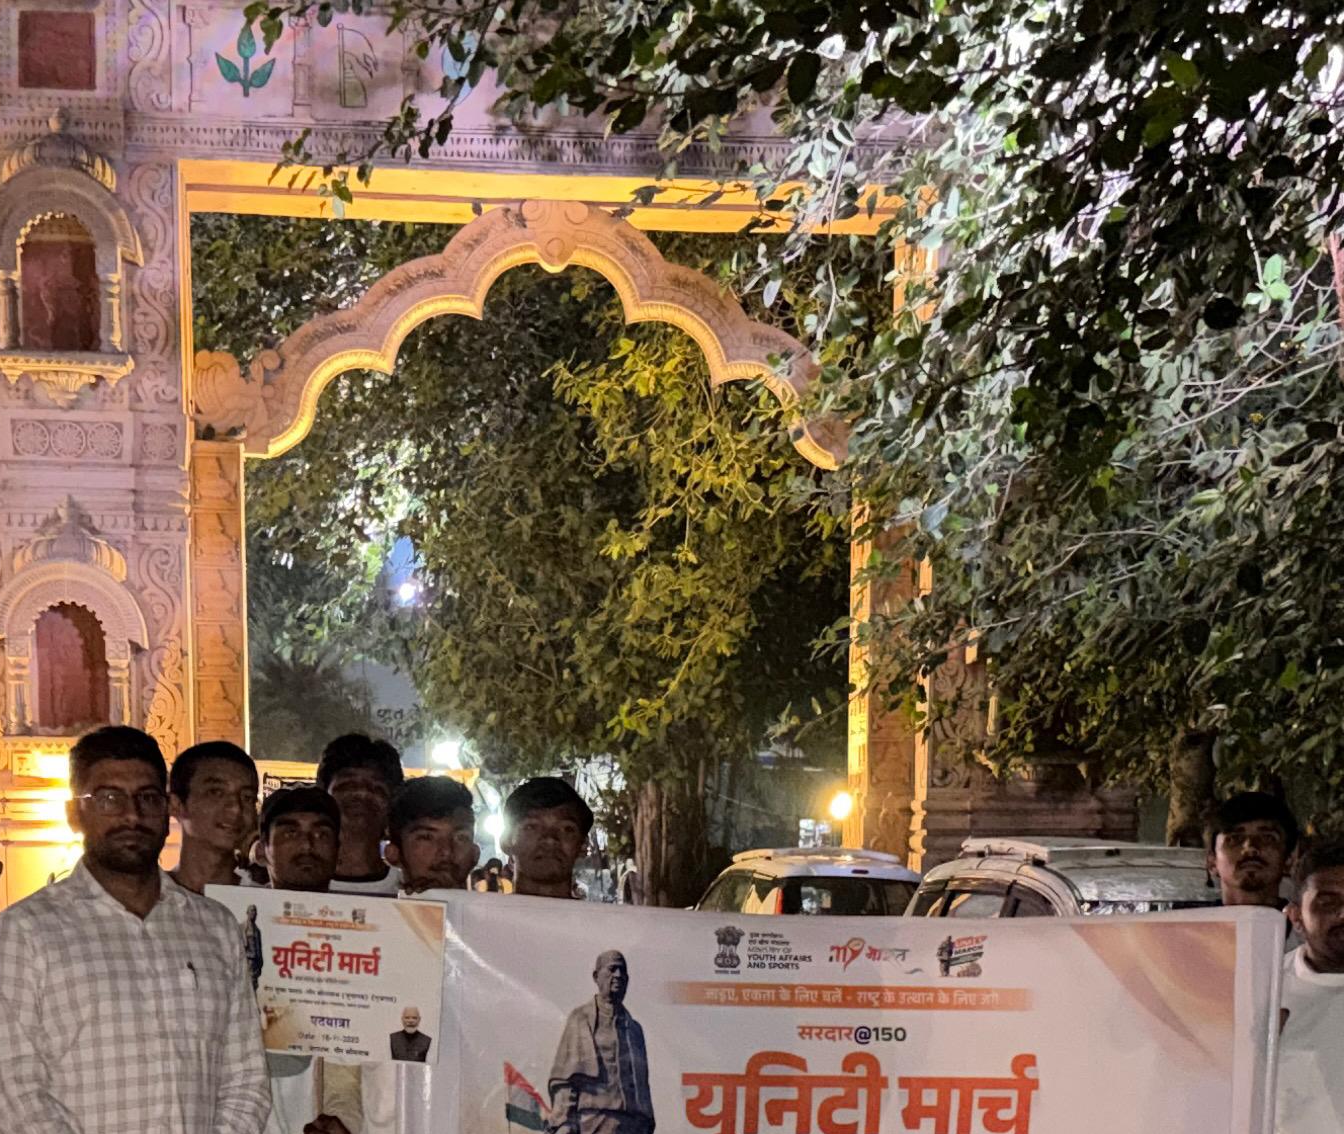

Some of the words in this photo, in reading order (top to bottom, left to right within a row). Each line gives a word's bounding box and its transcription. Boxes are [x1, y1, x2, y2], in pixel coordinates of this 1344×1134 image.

[272, 940, 333, 979] यूनिटी
[337, 947, 381, 976] मार्च
[779, 954, 812, 962] AFFAIRS
[795, 986, 818, 1002] लिए
[797, 1026, 907, 1044] सरदार@150
